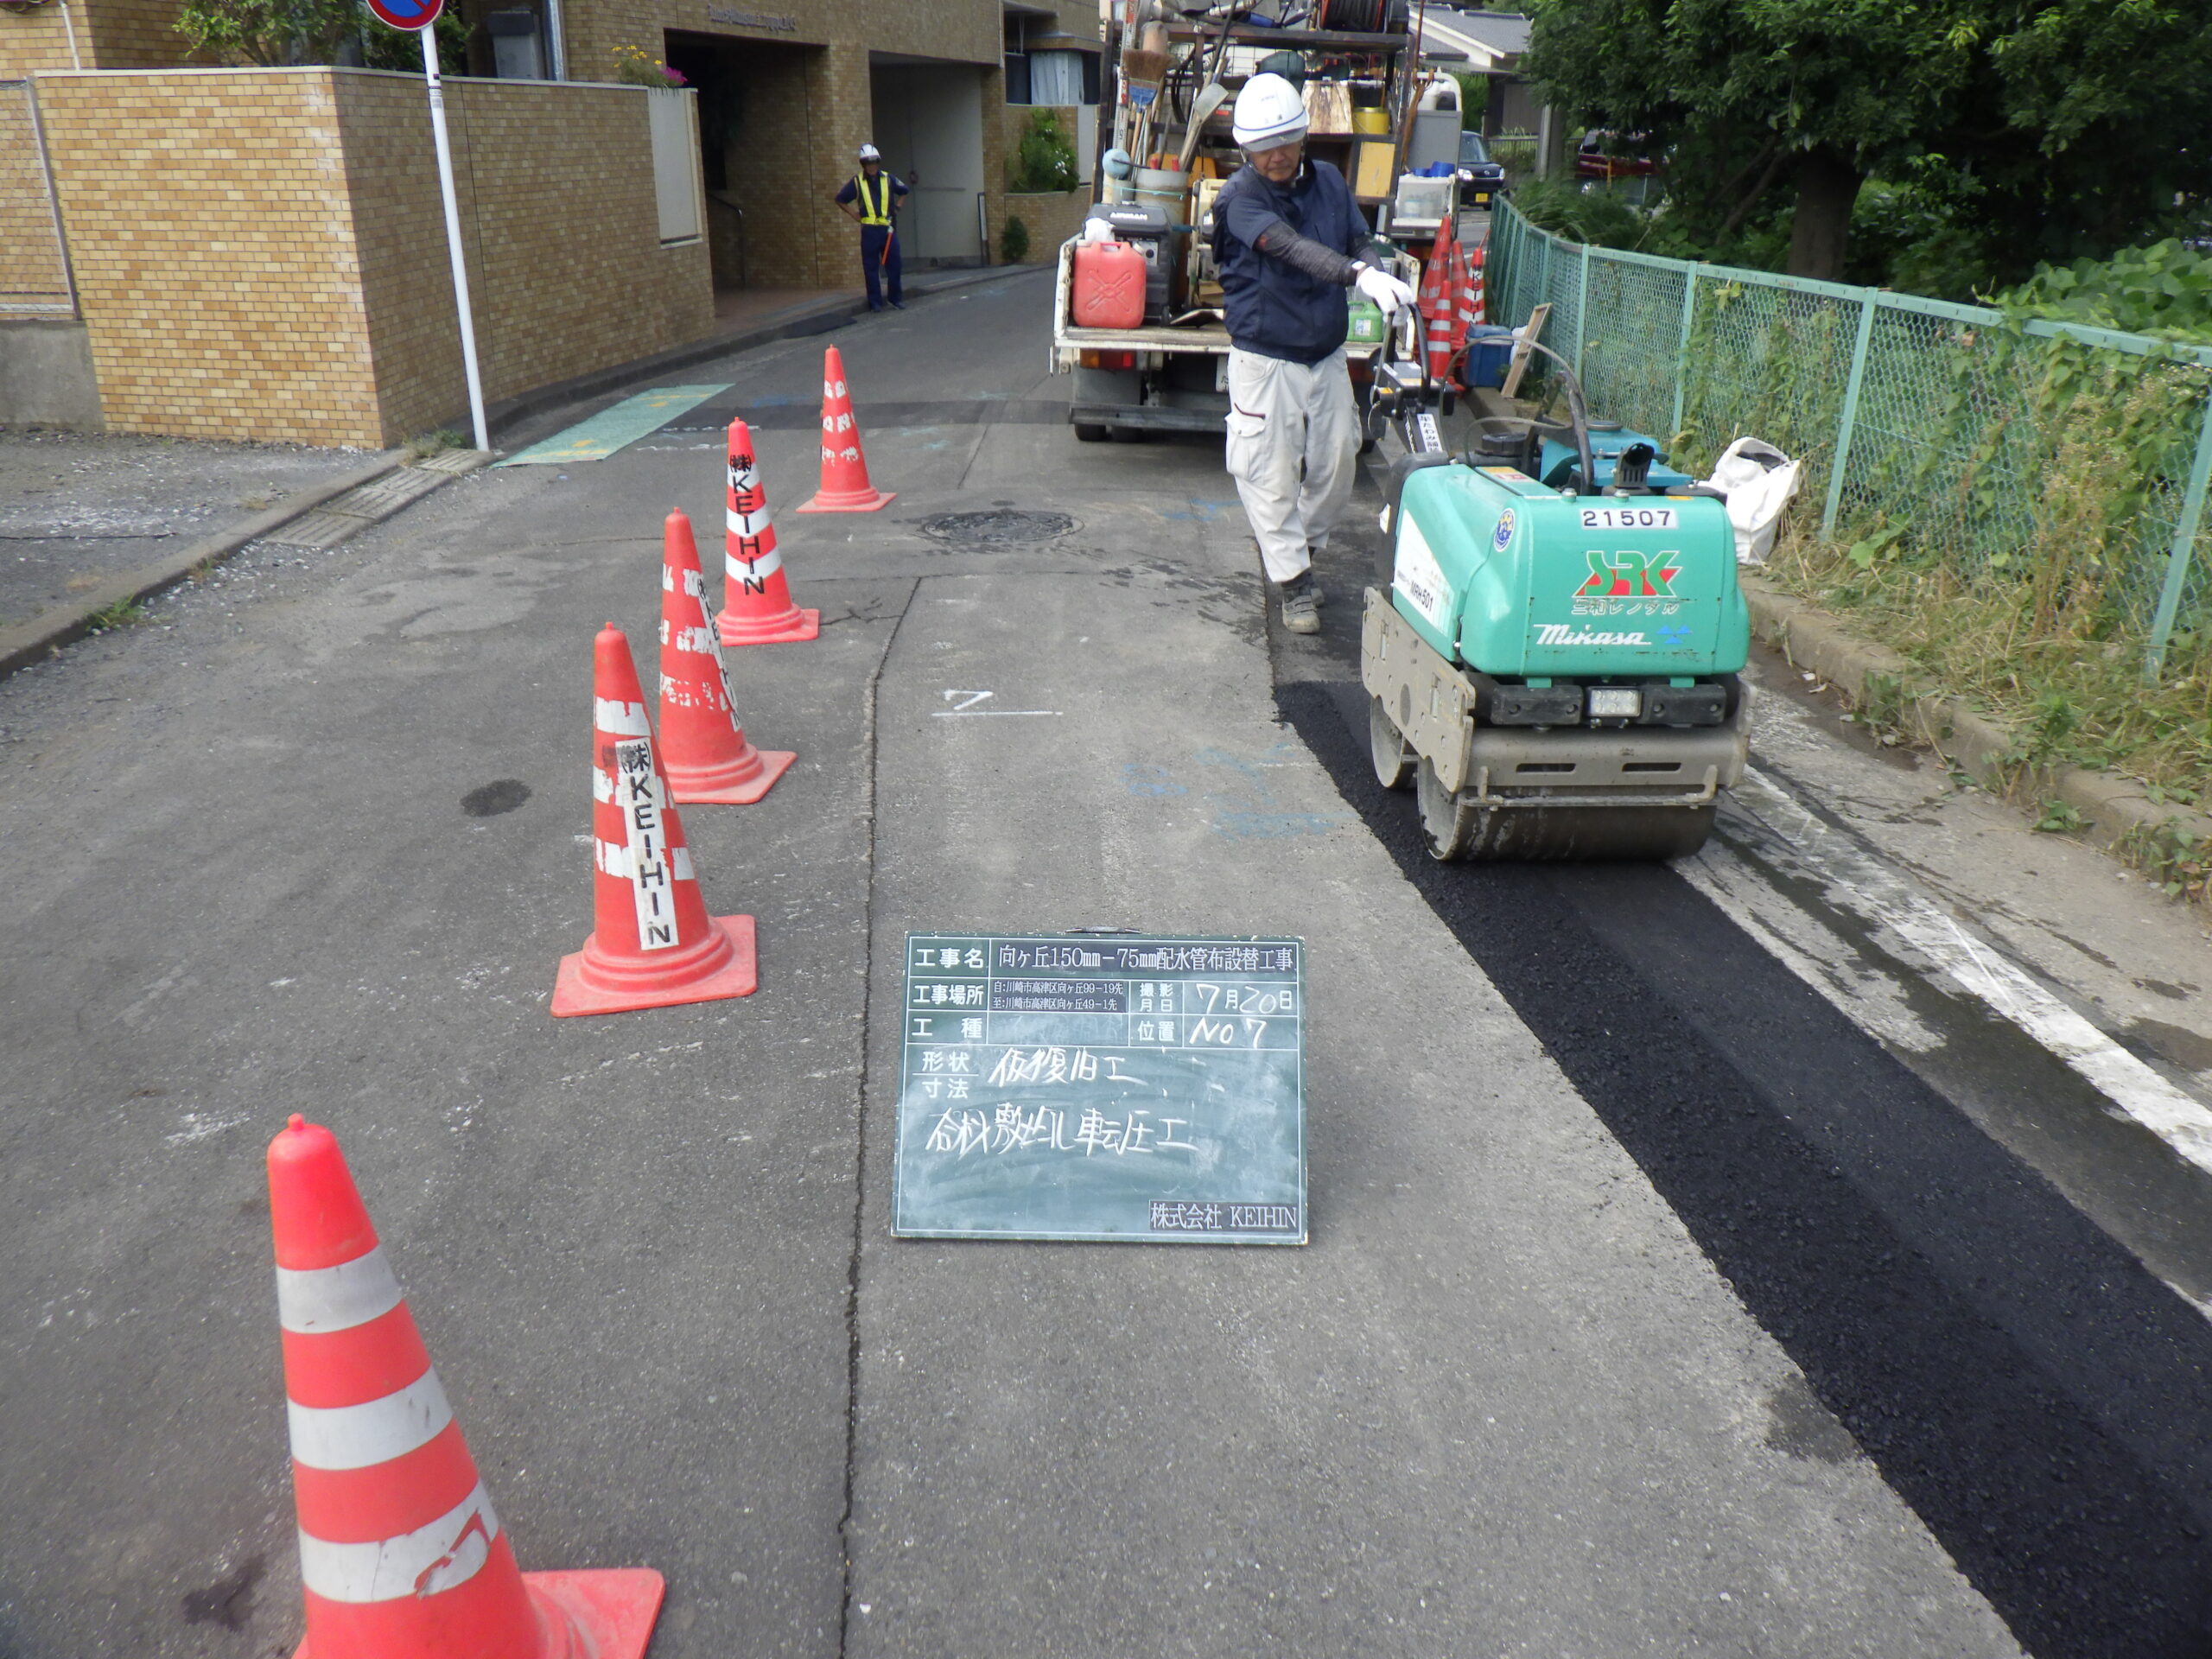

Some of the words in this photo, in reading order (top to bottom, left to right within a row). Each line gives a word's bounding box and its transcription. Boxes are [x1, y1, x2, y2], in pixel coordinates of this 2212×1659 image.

[1582, 510, 1671, 527] 21507
[1572, 550, 1684, 599] SRK
[1533, 623, 1652, 645] Mikasa
[914, 947, 984, 969] 工事名
[912, 983, 984, 1006] 工事場所
[1140, 982, 1173, 997] 撮影
[1196, 982, 1293, 1015] 7月20日
[1140, 998, 1173, 1013] 月日
[912, 1017, 983, 1039] 工種
[1137, 1020, 1175, 1041] 位置
[1189, 1016, 1234, 1045] No
[1246, 1017, 1267, 1049] 7
[921, 1050, 970, 1072] 形状
[988, 1046, 1149, 1087] 仮復旧工
[921, 1077, 969, 1099] 寸法
[1150, 1202, 1223, 1230] 株式会社
[1229, 1205, 1298, 1229] KEIHIN
